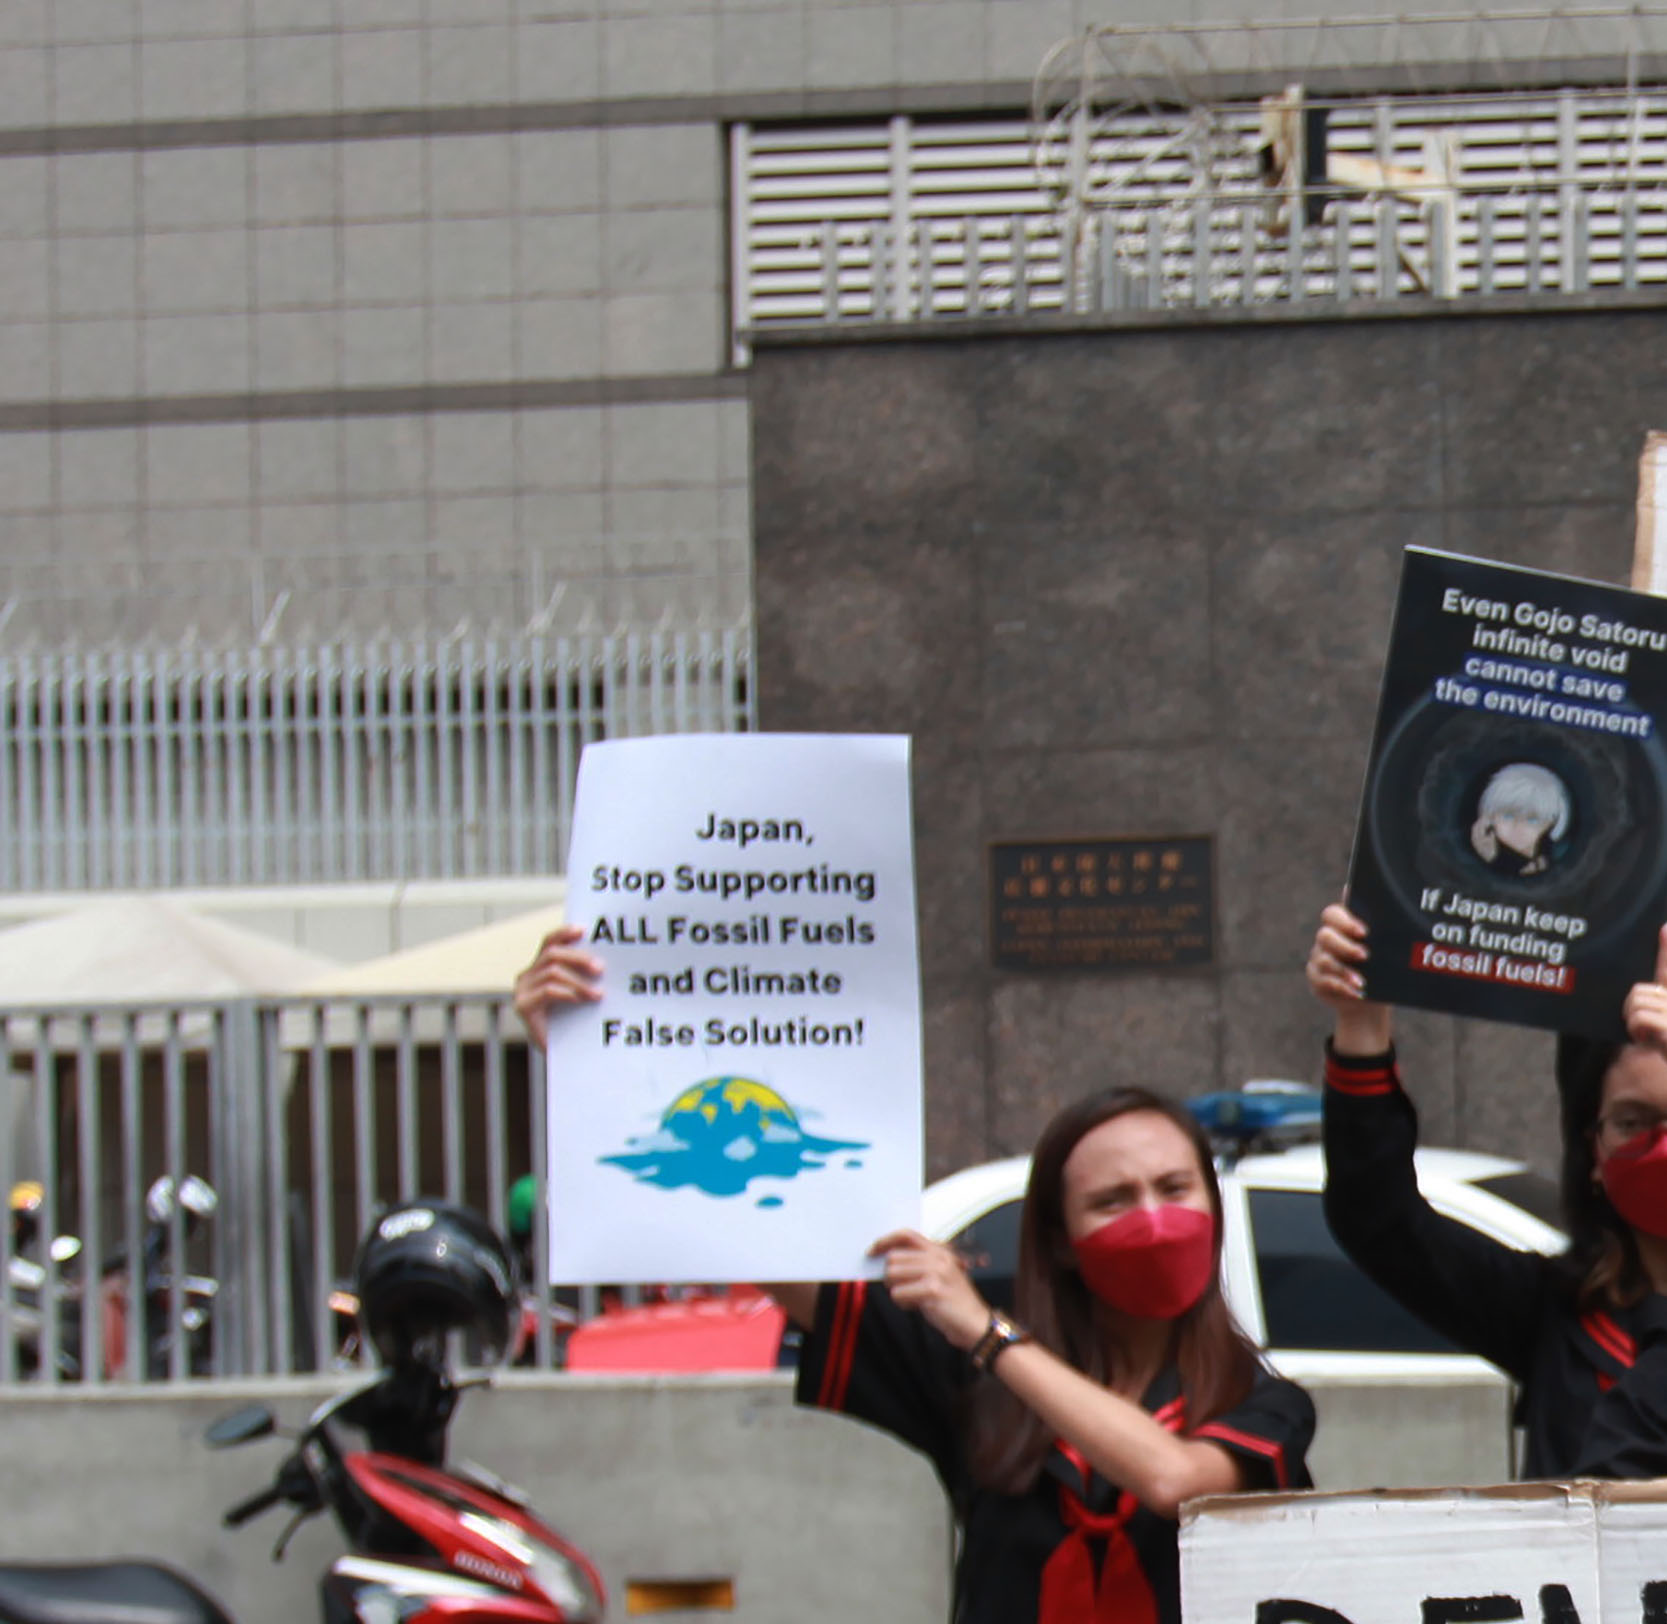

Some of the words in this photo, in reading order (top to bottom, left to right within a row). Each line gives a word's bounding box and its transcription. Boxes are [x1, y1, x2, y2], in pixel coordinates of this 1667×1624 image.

[1441, 588, 1508, 621] Even
[1514, 599, 1574, 635] Gojo
[1579, 609, 1667, 651] Satoru
[1472, 623, 1564, 661] infinite
[1571, 645, 1628, 673] void
[1465, 656, 1556, 690] cannot
[1561, 672, 1627, 702] save
[1435, 678, 1479, 706] the
[1483, 688, 1650, 737] environment
[697, 813, 815, 848] Japan,
[593, 866, 666, 900] Stop
[675, 864, 877, 903] Supporting
[591, 917, 659, 944] ALL
[668, 915, 771, 945] Fossil
[780, 914, 876, 945] Fuels
[1421, 888, 1441, 912] If
[1443, 890, 1520, 927] Japan
[1524, 905, 1587, 938] keep
[1432, 922, 1464, 945] on
[1469, 924, 1567, 964] funding
[629, 966, 694, 995] and
[703, 965, 842, 995] Climate
[1421, 944, 1491, 976] fossil
[1495, 957, 1568, 988] fuels!
[604, 1018, 695, 1046] False
[706, 1017, 864, 1046] Solution!
